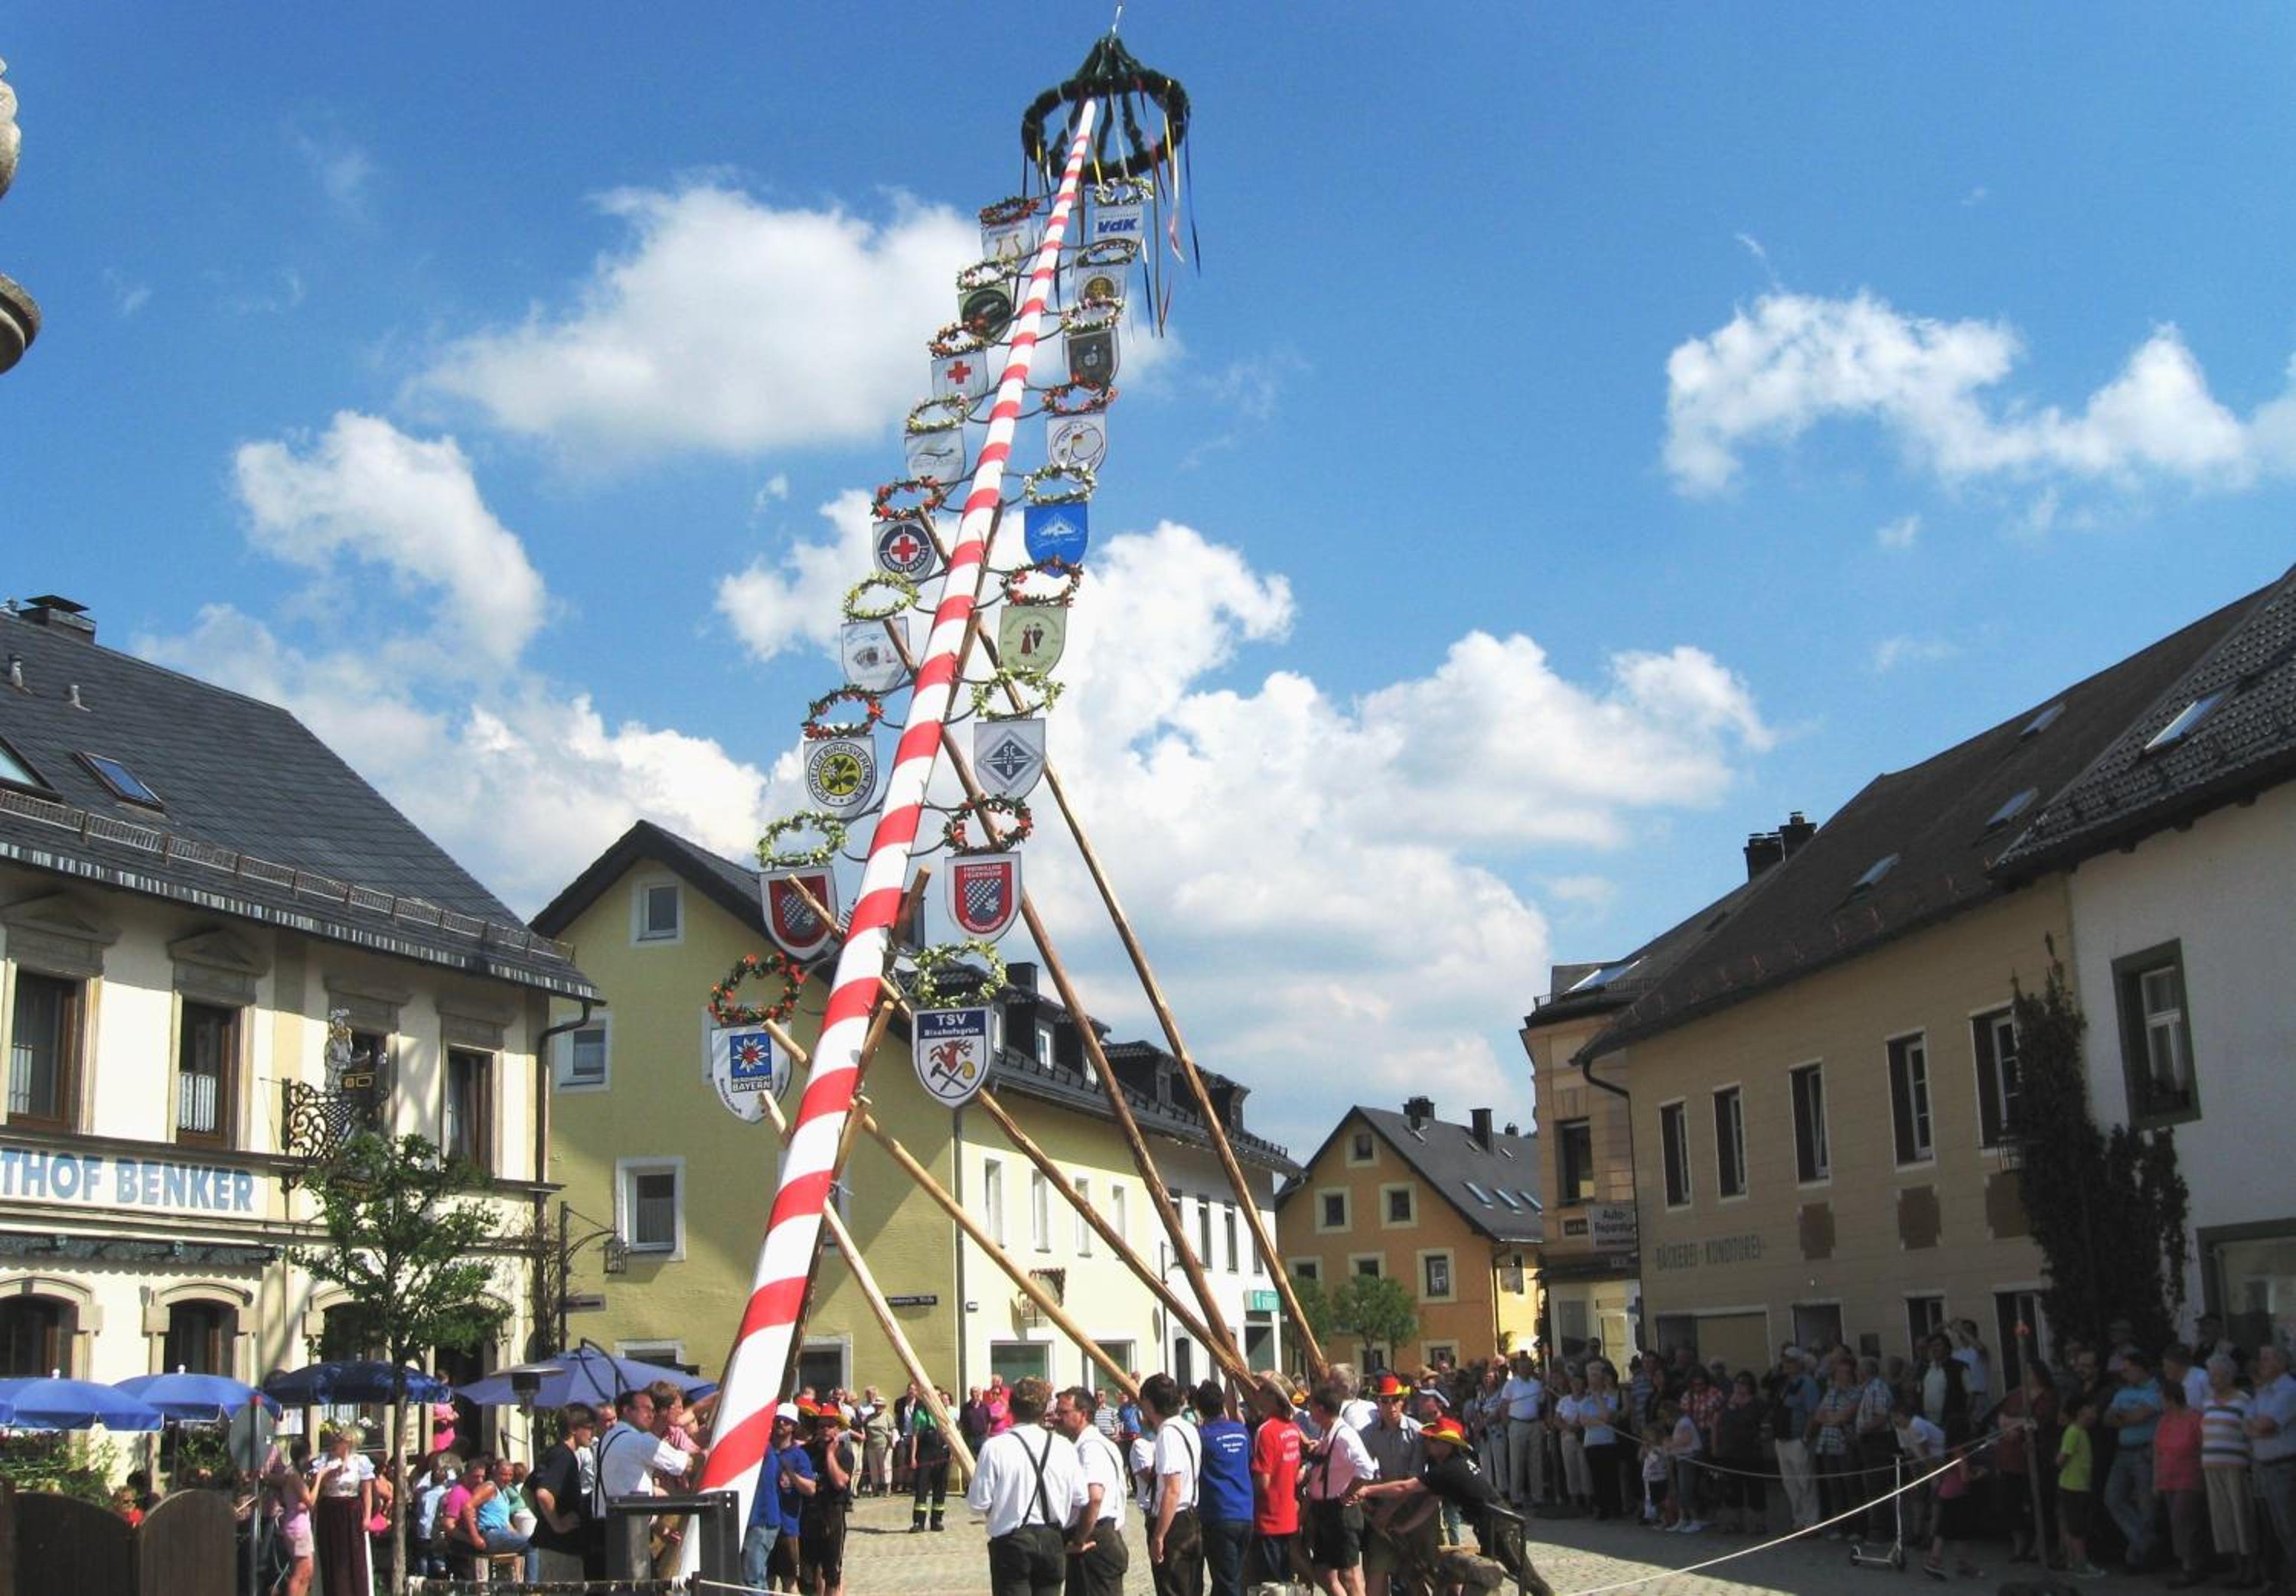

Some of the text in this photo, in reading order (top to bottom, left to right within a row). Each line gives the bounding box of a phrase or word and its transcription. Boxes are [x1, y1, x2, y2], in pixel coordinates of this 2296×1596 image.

[1097, 219, 1137, 233] VdK
[1003, 745, 1016, 757] SC
[935, 1014, 967, 1026] TSV
[732, 1080, 771, 1092] BAYERN
[0, 1148, 253, 1211] THOF BENKER
